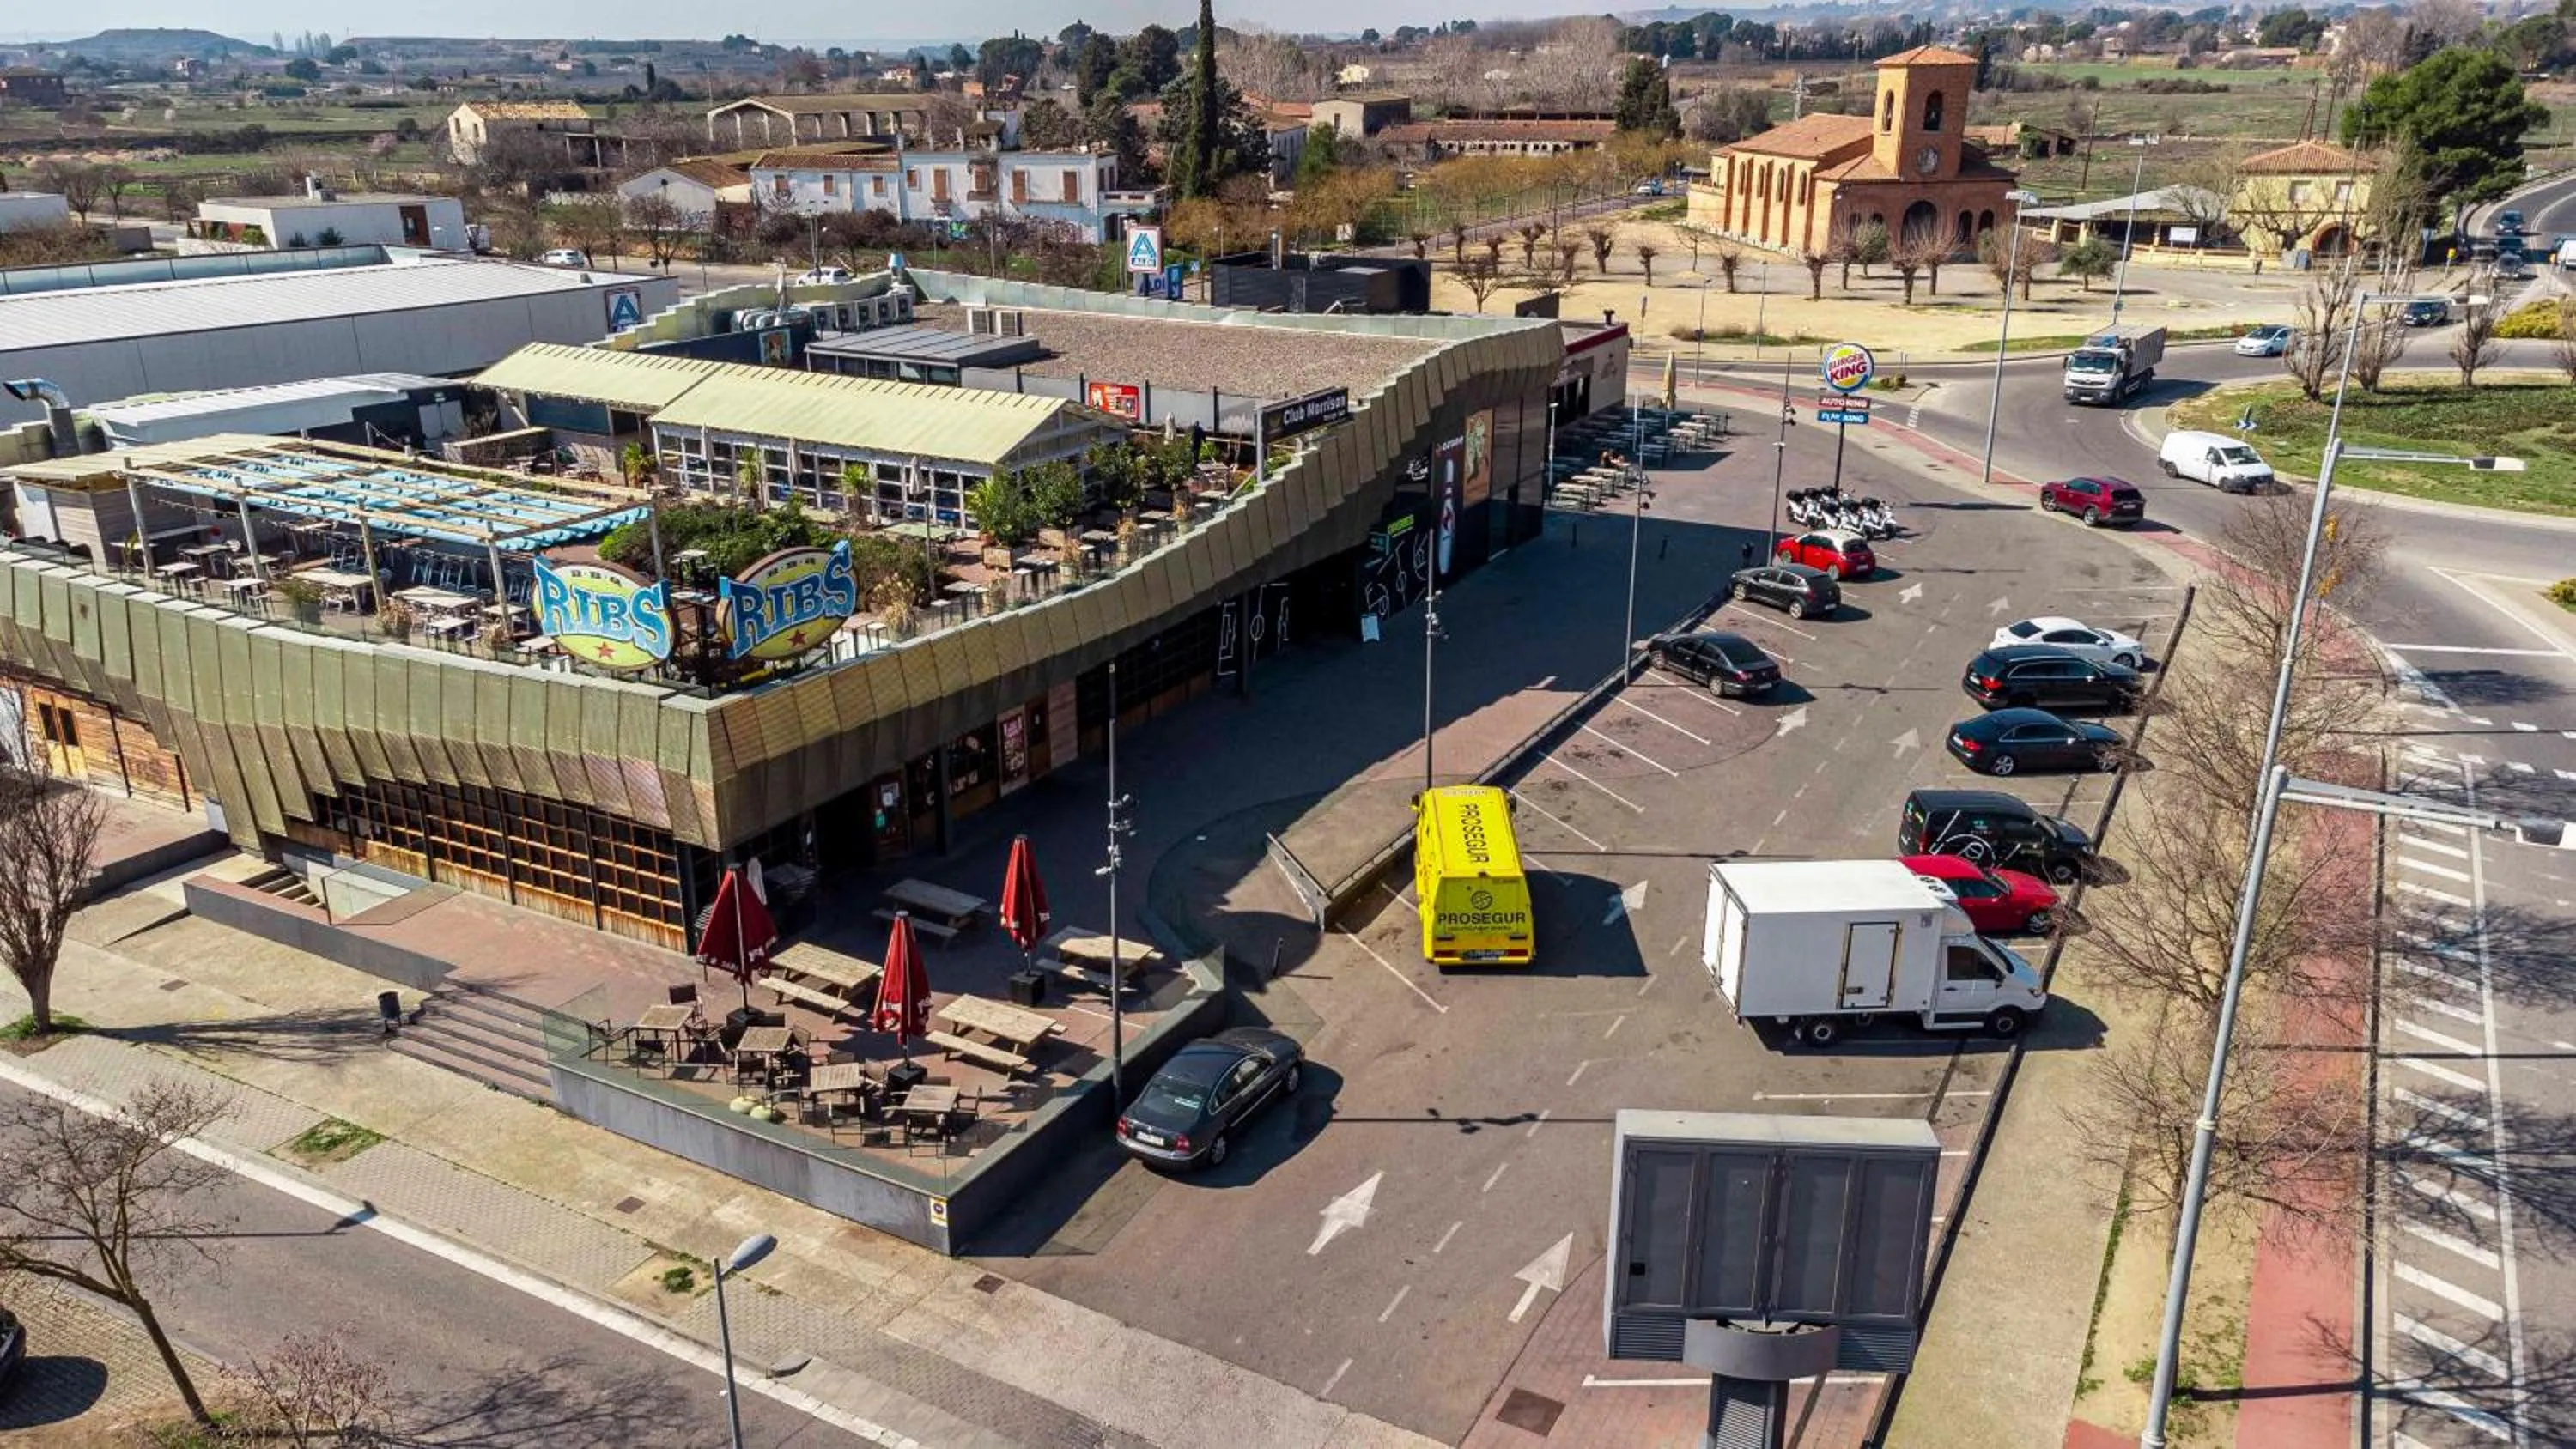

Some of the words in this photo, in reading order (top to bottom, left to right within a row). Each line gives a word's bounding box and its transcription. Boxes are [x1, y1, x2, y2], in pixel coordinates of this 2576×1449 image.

[1131, 257, 1157, 267] ALDI
[1829, 354, 1864, 371] BURGER
[1831, 361, 1868, 383] KING
[1284, 404, 1305, 426] Club
[533, 557, 671, 660] RIBS
[727, 539, 857, 660] RIBS
[1460, 803, 1490, 863] PROSEGUR
[1437, 912, 1526, 925] PROSEGUR
